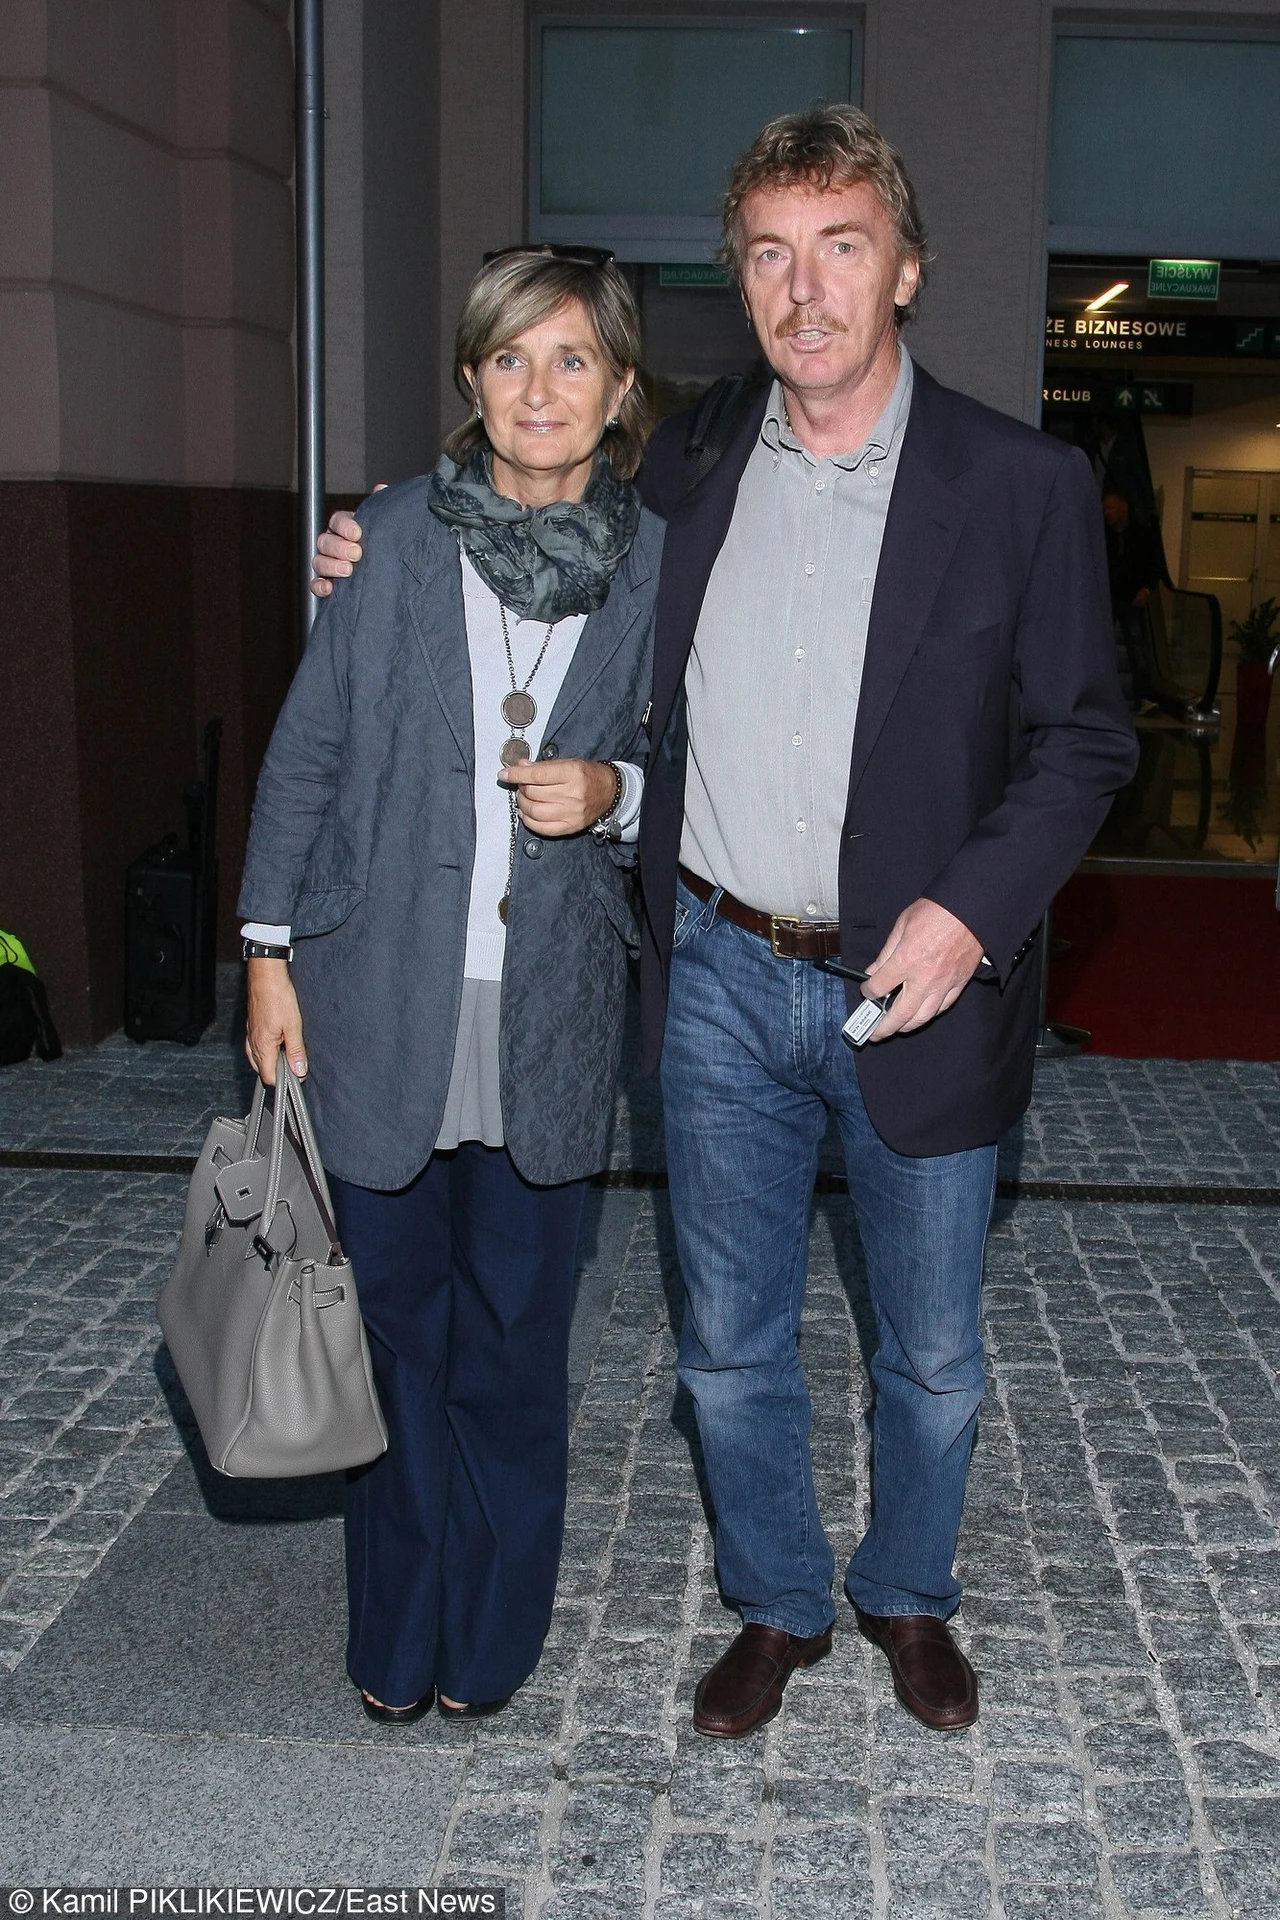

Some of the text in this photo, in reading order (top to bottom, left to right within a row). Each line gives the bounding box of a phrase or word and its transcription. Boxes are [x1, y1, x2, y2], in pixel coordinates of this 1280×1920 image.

[1075, 320, 1187, 337] BIZNESOWE
[1045, 338, 1143, 350] NESS LOUNGES
[1052, 389, 1091, 402] CLUB
